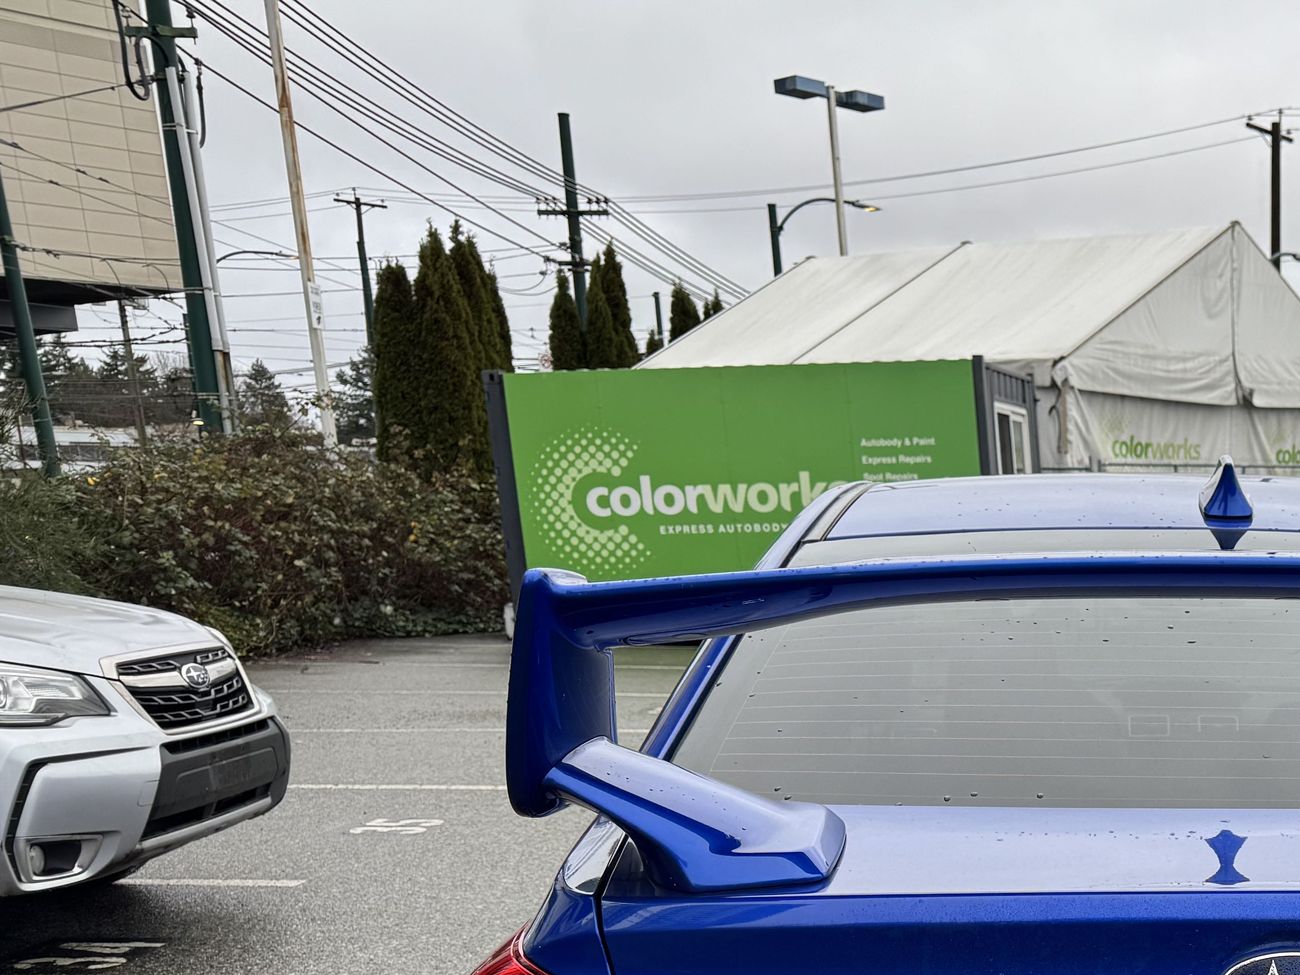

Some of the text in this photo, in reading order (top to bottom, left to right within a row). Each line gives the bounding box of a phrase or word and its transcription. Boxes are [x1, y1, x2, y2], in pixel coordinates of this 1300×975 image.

[860, 437, 936, 448] Autobody & Paint
[1111, 436, 1201, 460] colorworks
[861, 454, 932, 465] Express Repairs
[660, 524, 715, 535] EXPRESS
